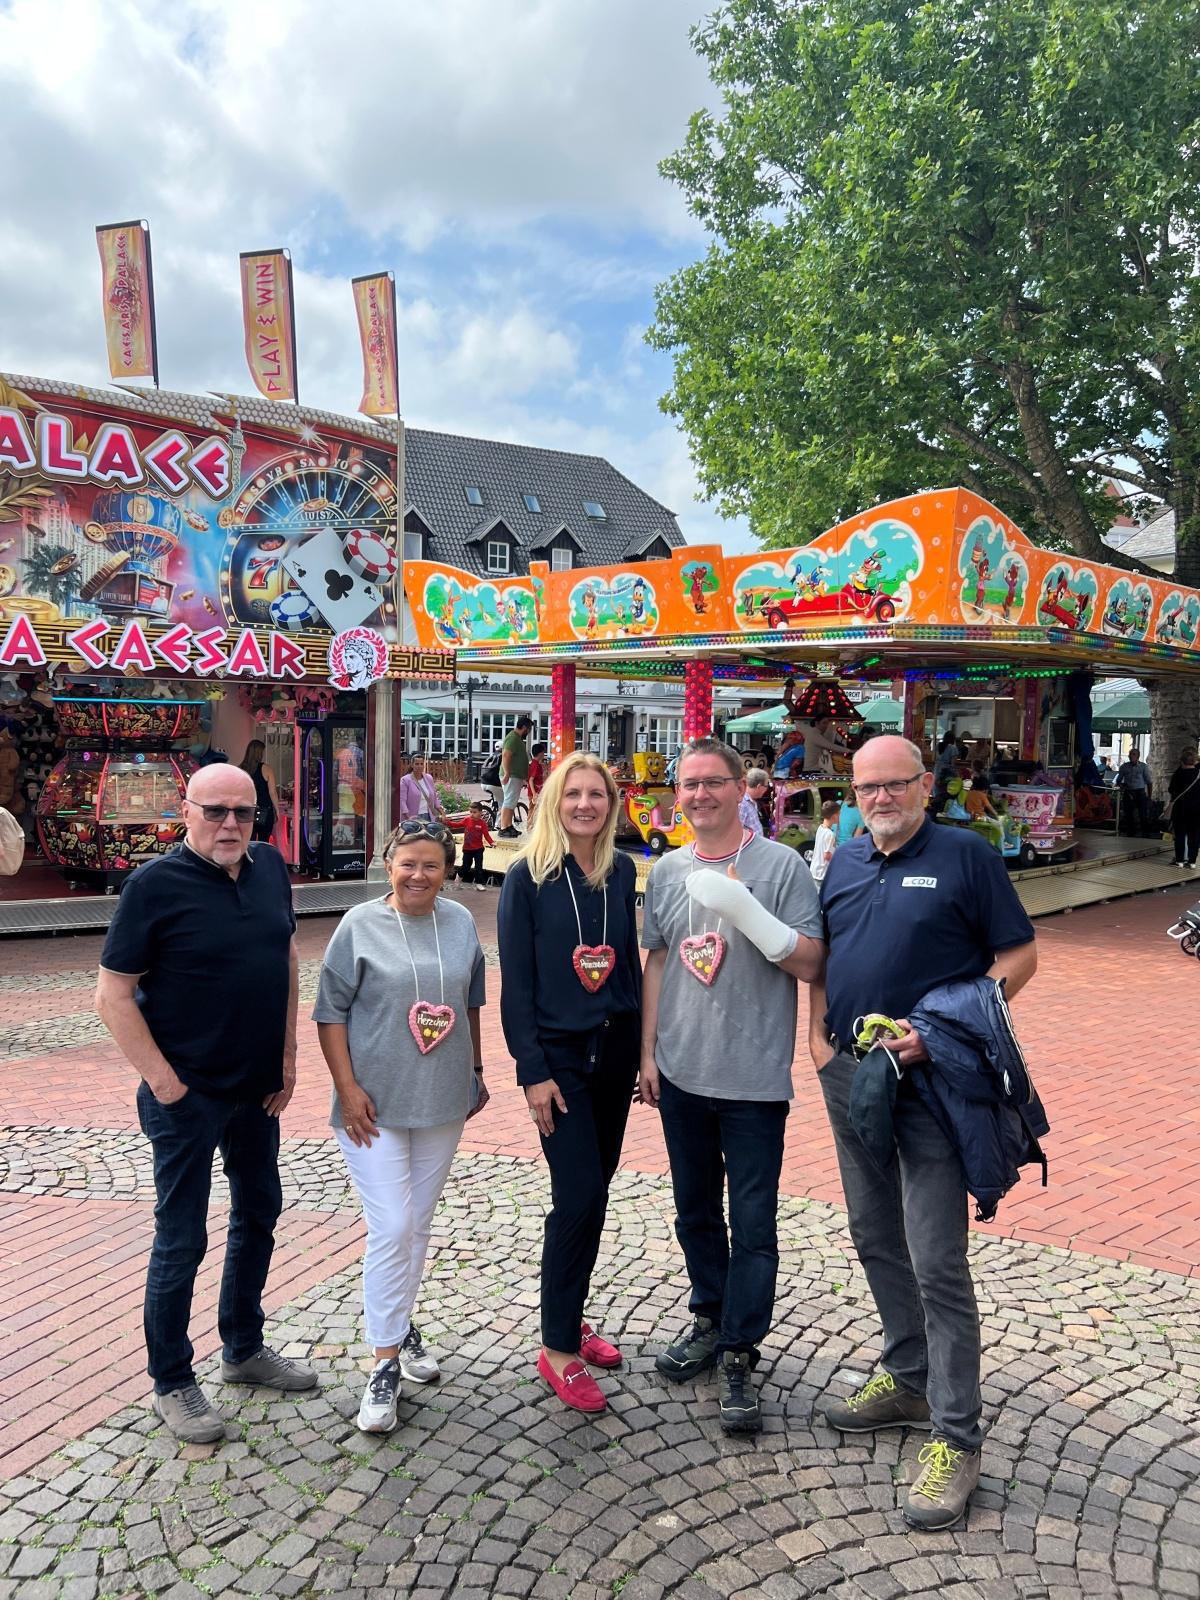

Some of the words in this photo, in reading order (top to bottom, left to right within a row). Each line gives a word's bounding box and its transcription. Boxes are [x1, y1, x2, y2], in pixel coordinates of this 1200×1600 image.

[116, 235, 128, 287] PALACE
[255, 263, 274, 306] WIN
[259, 334, 282, 392] PLAY
[0, 614, 47, 666] A
[67, 617, 307, 679] CAESAR
[911, 878, 935, 887] CDU
[416, 1013, 449, 1028] Herzchen
